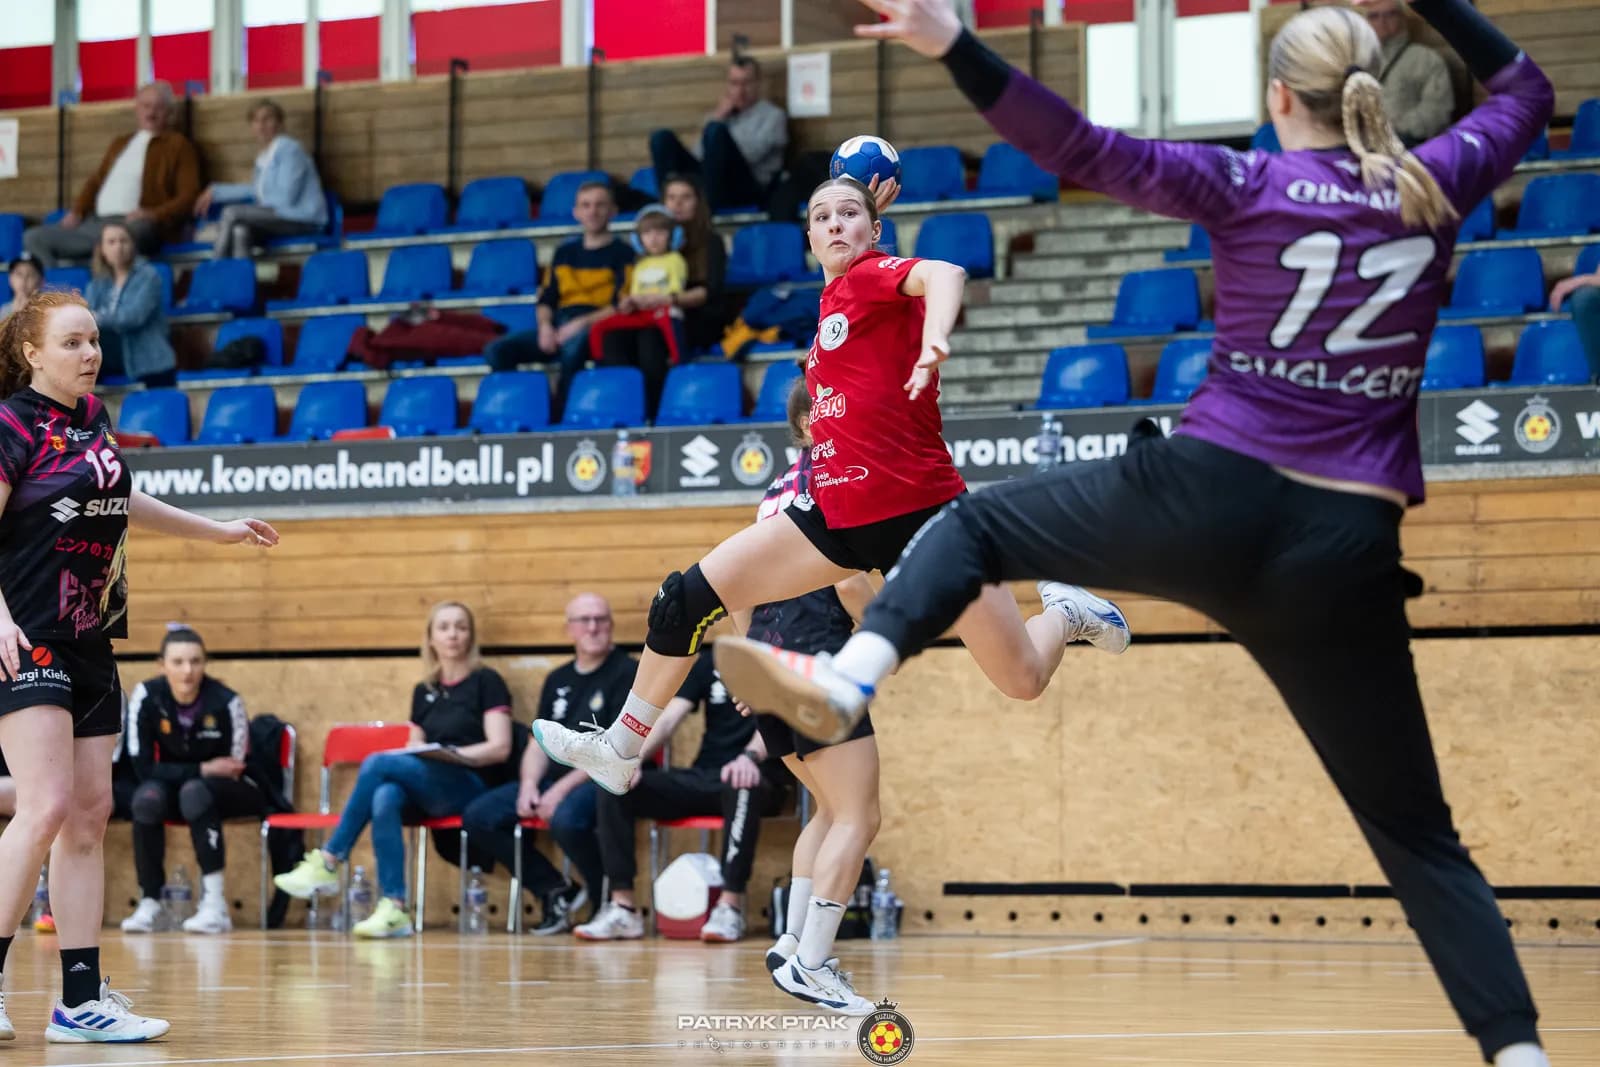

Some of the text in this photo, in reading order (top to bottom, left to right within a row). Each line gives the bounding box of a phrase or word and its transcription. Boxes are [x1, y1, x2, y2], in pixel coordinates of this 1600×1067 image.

[1269, 231, 1436, 355] 12
[85, 448, 122, 489] 15
[13, 668, 39, 682] argi
